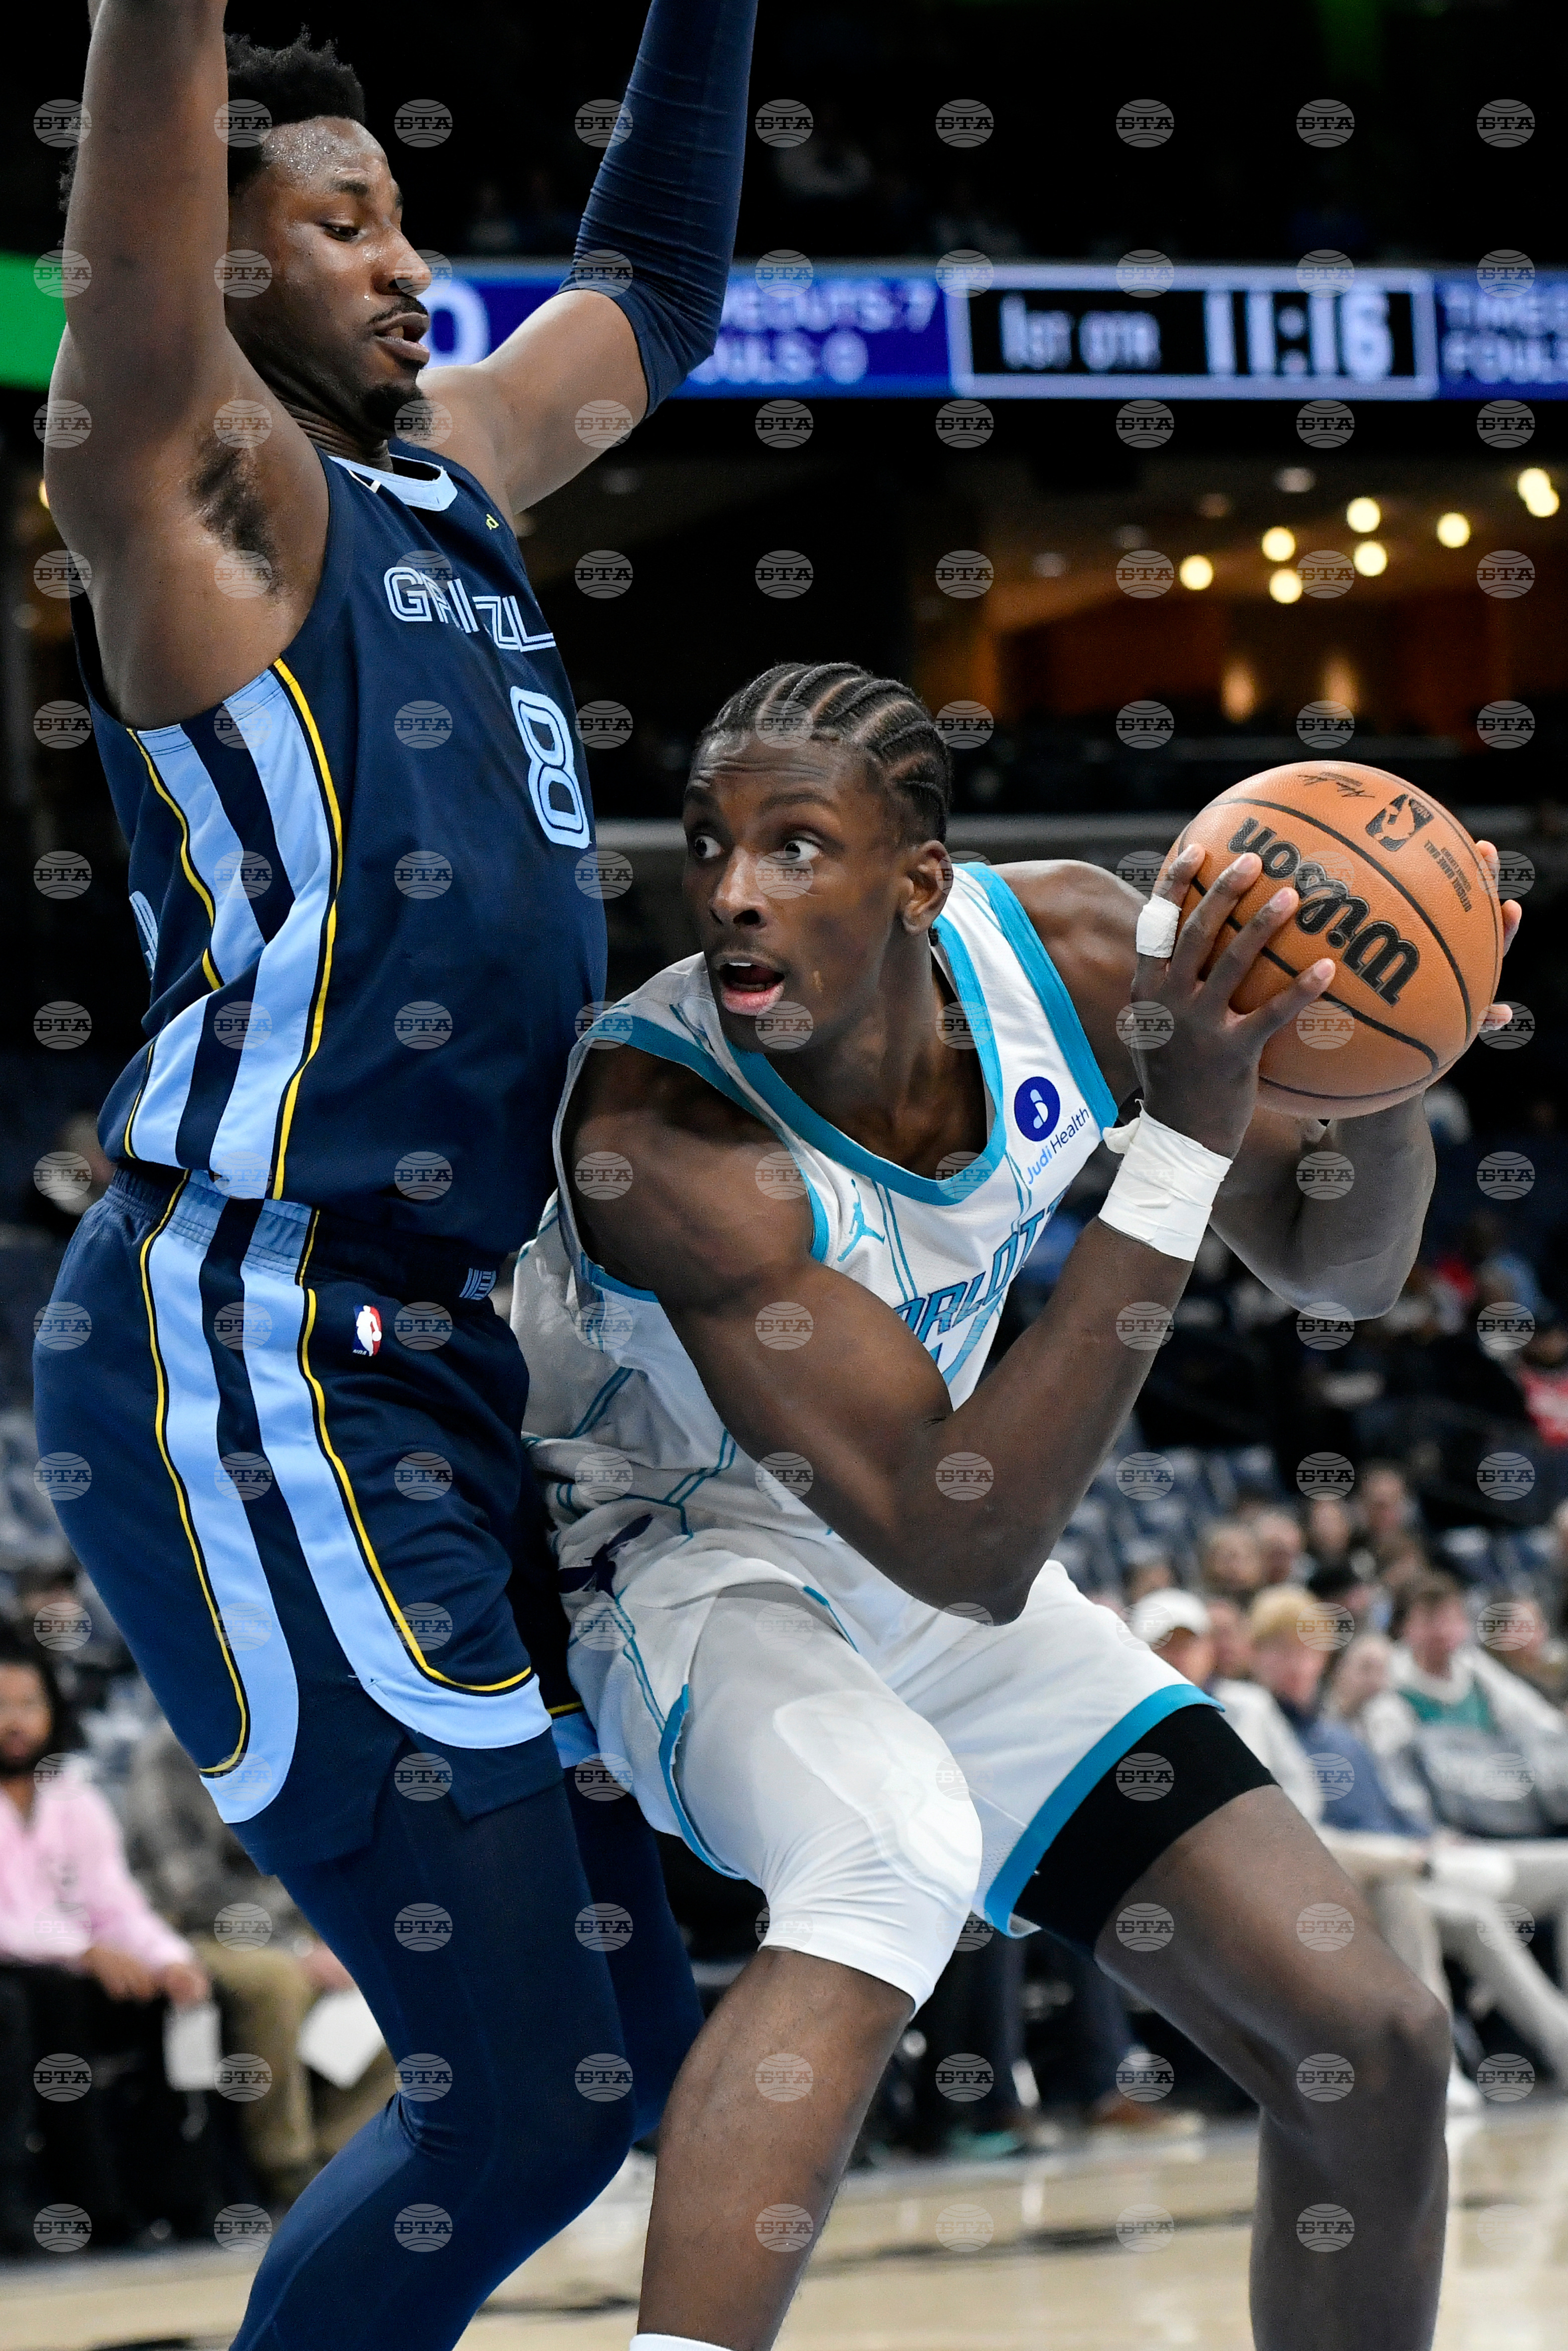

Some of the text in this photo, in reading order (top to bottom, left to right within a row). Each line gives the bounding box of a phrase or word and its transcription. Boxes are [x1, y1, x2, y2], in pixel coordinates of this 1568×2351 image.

[1204, 286, 1395, 382] 11:16
[510, 686, 592, 849] 8
[1228, 817, 1420, 1007] Wilson
[1028, 1108, 1090, 1185] Judi Health
